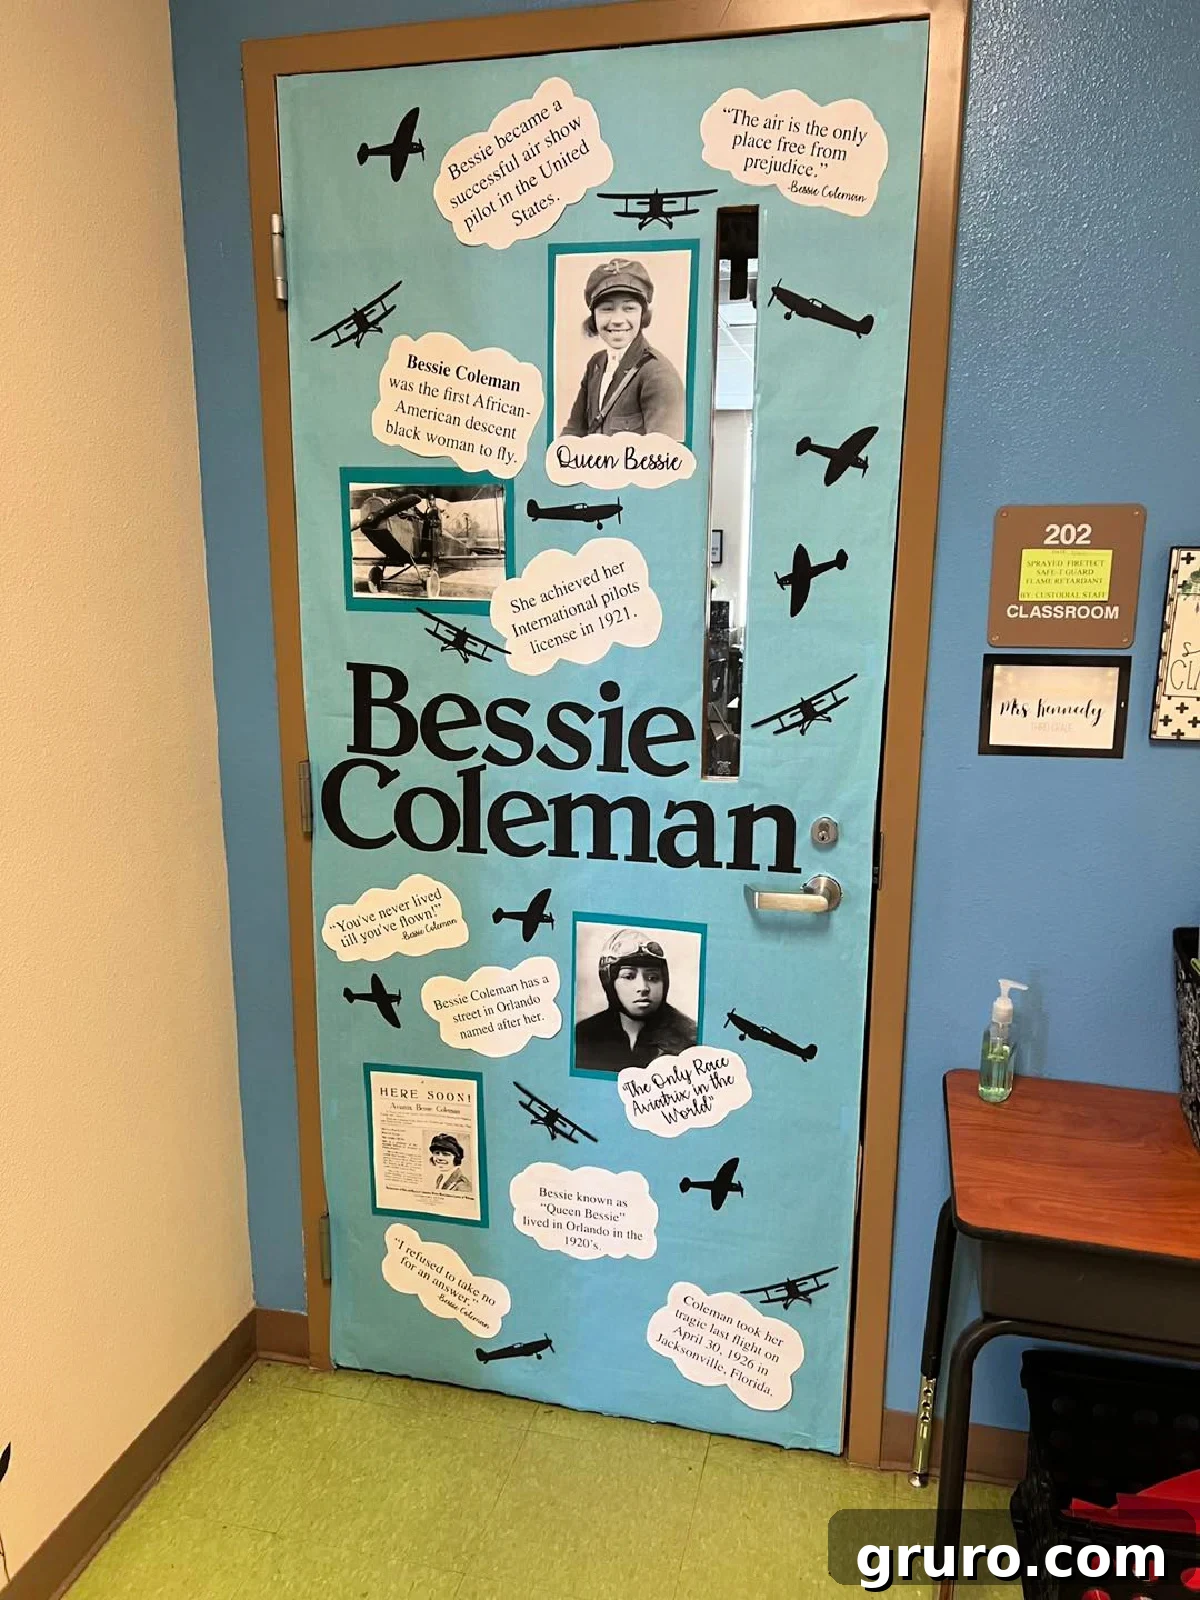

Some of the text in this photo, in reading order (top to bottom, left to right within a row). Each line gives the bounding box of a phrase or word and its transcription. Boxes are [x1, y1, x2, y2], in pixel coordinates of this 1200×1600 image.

[448, 100, 562, 180] Bessie became a
[732, 132, 847, 161] place free from
[763, 114, 784, 130] air
[788, 117, 800, 133] is
[806, 120, 828, 137] the
[833, 127, 868, 147] only
[450, 116, 582, 209] successful air show
[464, 139, 590, 232] pilot in the United
[821, 186, 867, 203] Coleman
[511, 193, 560, 226] States.
[407, 354, 520, 392] Bessie Coleman
[389, 377, 531, 418] was the first African-
[394, 400, 516, 439] American descent
[385, 419, 518, 465] black woman to fly.
[556, 445, 683, 471] Queen Bessie
[1043, 523, 1092, 545] 202
[510, 561, 625, 614] She achieved her
[511, 581, 640, 638] International pilots
[1007, 606, 1120, 619] CLASSROOM
[529, 606, 639, 655] license in 1921.
[345, 661, 696, 777] Bessie
[1036, 699, 1102, 728] Kennedy
[321, 757, 803, 874] Coleman
[378, 900, 410, 920] never
[412, 888, 442, 908] lived
[340, 930, 358, 948] till
[359, 921, 398, 944] you've
[433, 976, 550, 1011] Bessie Coleman has a
[452, 995, 541, 1023] street in Orlando
[459, 1013, 545, 1040] named after her.
[651, 1066, 692, 1089] Only
[692, 1057, 729, 1076] Race
[379, 1087, 472, 1103] HERE SOON!
[632, 1071, 734, 1117] Aviatrix in the
[539, 1187, 628, 1208] Bessie known as
[523, 1216, 643, 1241] lived in Orlando in the
[400, 1257, 417, 1272] for
[417, 1268, 430, 1281] an
[406, 1248, 444, 1274] refused
[445, 1271, 457, 1282] to
[457, 1279, 480, 1297] take
[481, 1293, 496, 1307] no
[675, 1309, 780, 1363] tragic last flight on
[683, 1295, 784, 1347] Coleman took her
[656, 1333, 773, 1397] Jacksonville, Florida.
[673, 1326, 769, 1376] April 30, 1926 in
